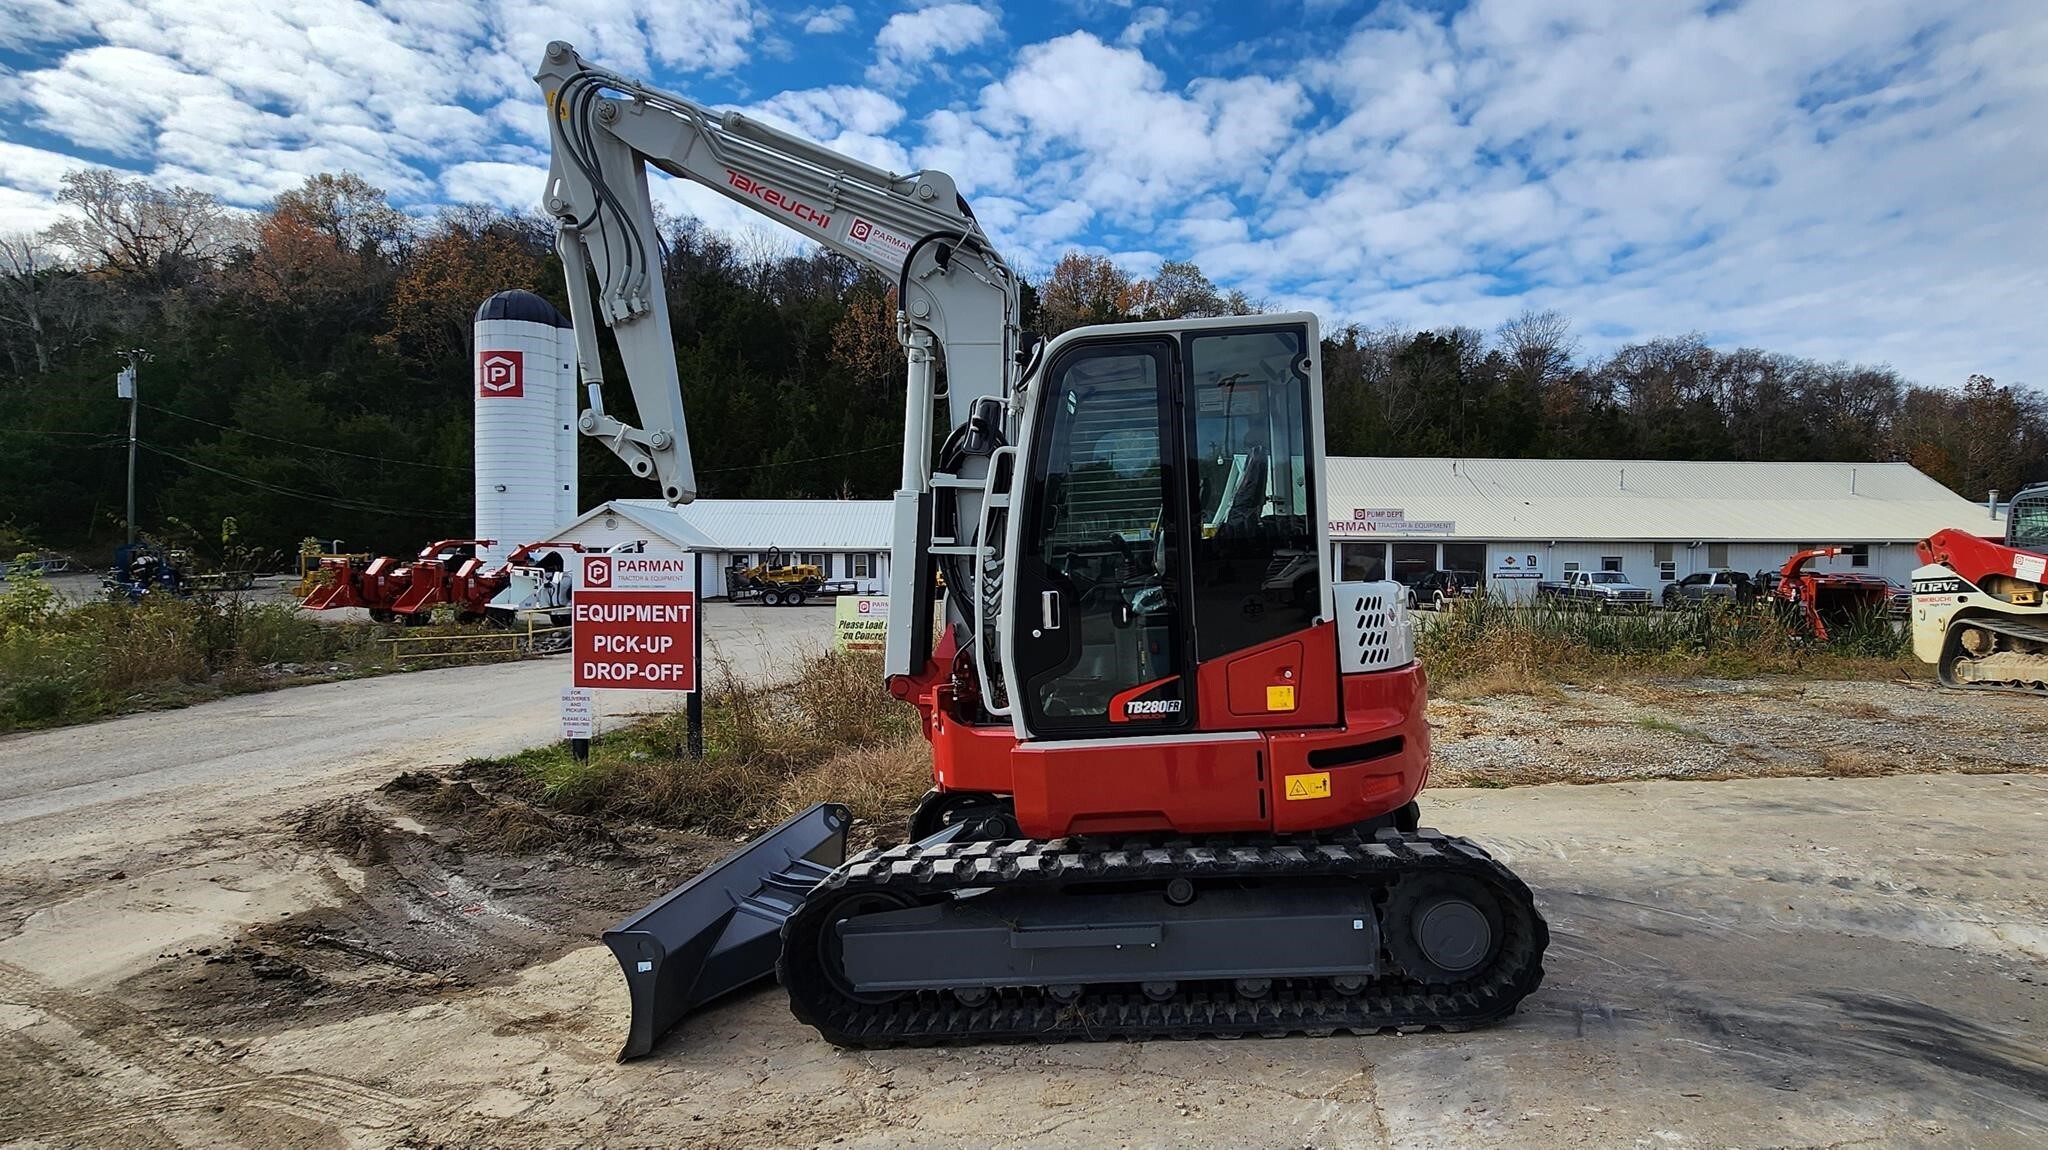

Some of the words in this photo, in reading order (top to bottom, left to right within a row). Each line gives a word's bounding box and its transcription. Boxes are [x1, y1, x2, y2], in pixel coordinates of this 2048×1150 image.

[726, 169, 831, 229] TAKEUCHI
[872, 229, 913, 251] PARMAN
[491, 367, 507, 382] P
[1328, 521, 1377, 531] ARMAN
[593, 567, 604, 578] P
[617, 560, 684, 572] PARMAN
[576, 604, 691, 623] EQUIPMENT
[838, 620, 865, 629] Please
[865, 620, 884, 630] Load
[842, 632, 854, 640] on
[854, 631, 887, 640] Concret
[593, 635, 673, 654] PICK-UP
[583, 662, 684, 681] DROP-OFF
